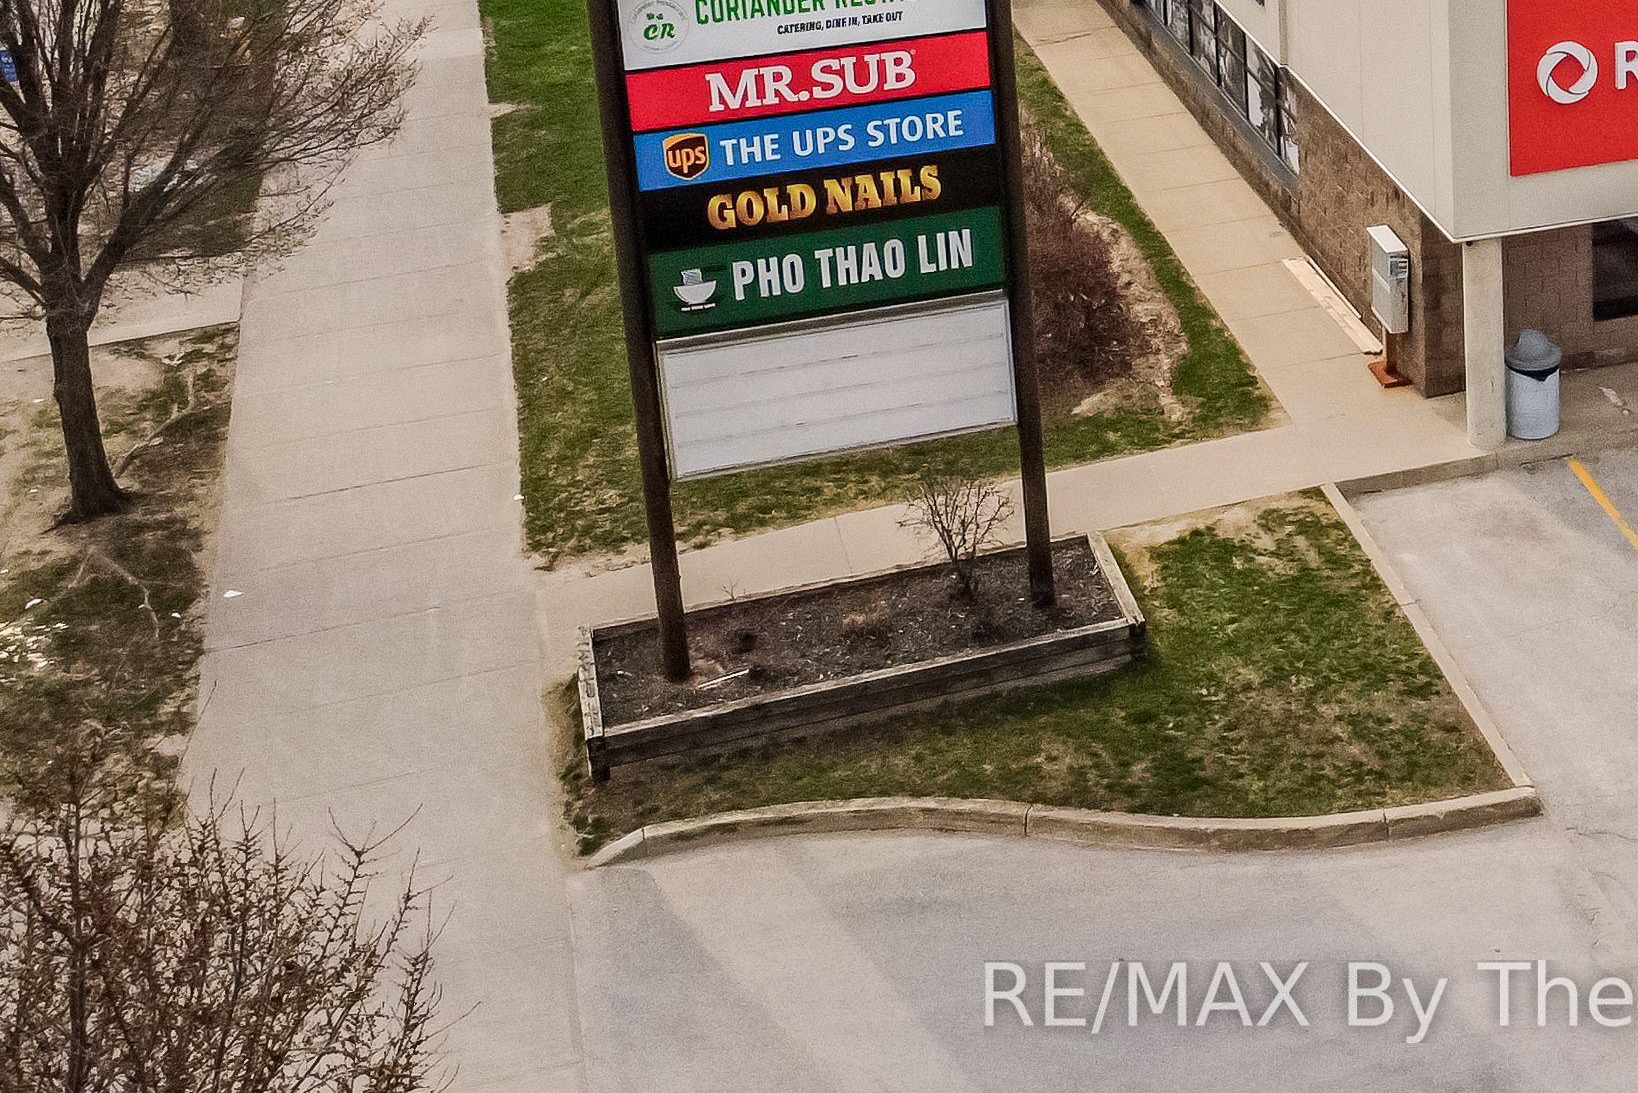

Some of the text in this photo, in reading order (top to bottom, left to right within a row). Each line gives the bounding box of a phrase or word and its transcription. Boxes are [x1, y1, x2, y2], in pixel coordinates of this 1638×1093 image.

[777, 20, 824, 35] CATERING,
[862, 13, 884, 25] TAKE
[885, 11, 904, 22] OUT
[705, 50, 916, 112] MR.SUB
[664, 142, 708, 176] ups
[720, 109, 964, 166] THE UPS STORE
[706, 164, 943, 230] GOLD NAILS
[731, 228, 974, 301] PHO THAO LIN
